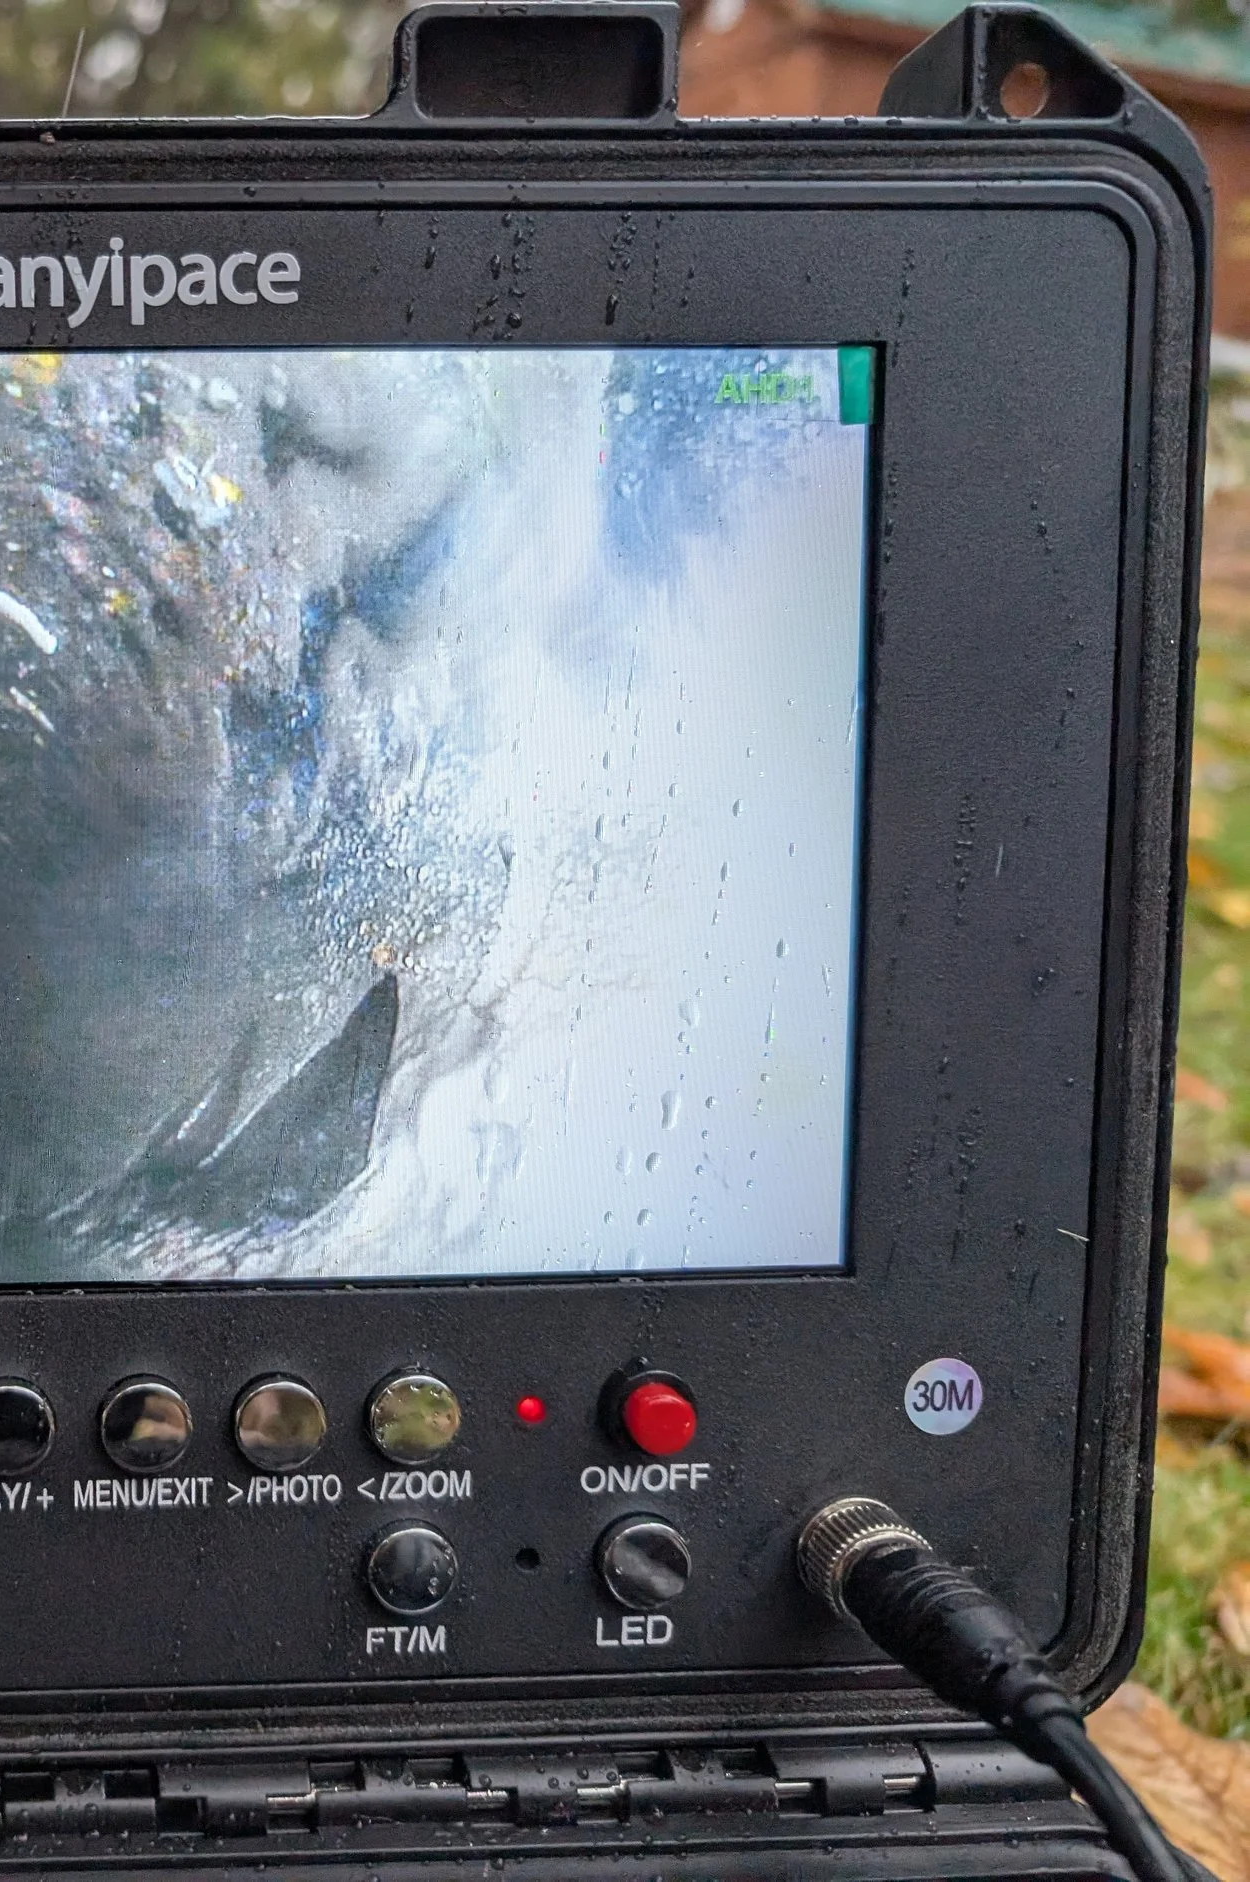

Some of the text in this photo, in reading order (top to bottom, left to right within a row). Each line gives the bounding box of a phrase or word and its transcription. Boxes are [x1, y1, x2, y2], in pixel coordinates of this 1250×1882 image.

[911, 1380, 976, 1414] 30M
[72, 1475, 214, 1509] MENU/EXIT
[225, 1472, 343, 1506] >/PHOTO
[355, 1469, 473, 1502] </ZOOM
[579, 1462, 711, 1494] ON/OFF
[364, 1624, 448, 1656] FT/M
[594, 1615, 674, 1648] LED
